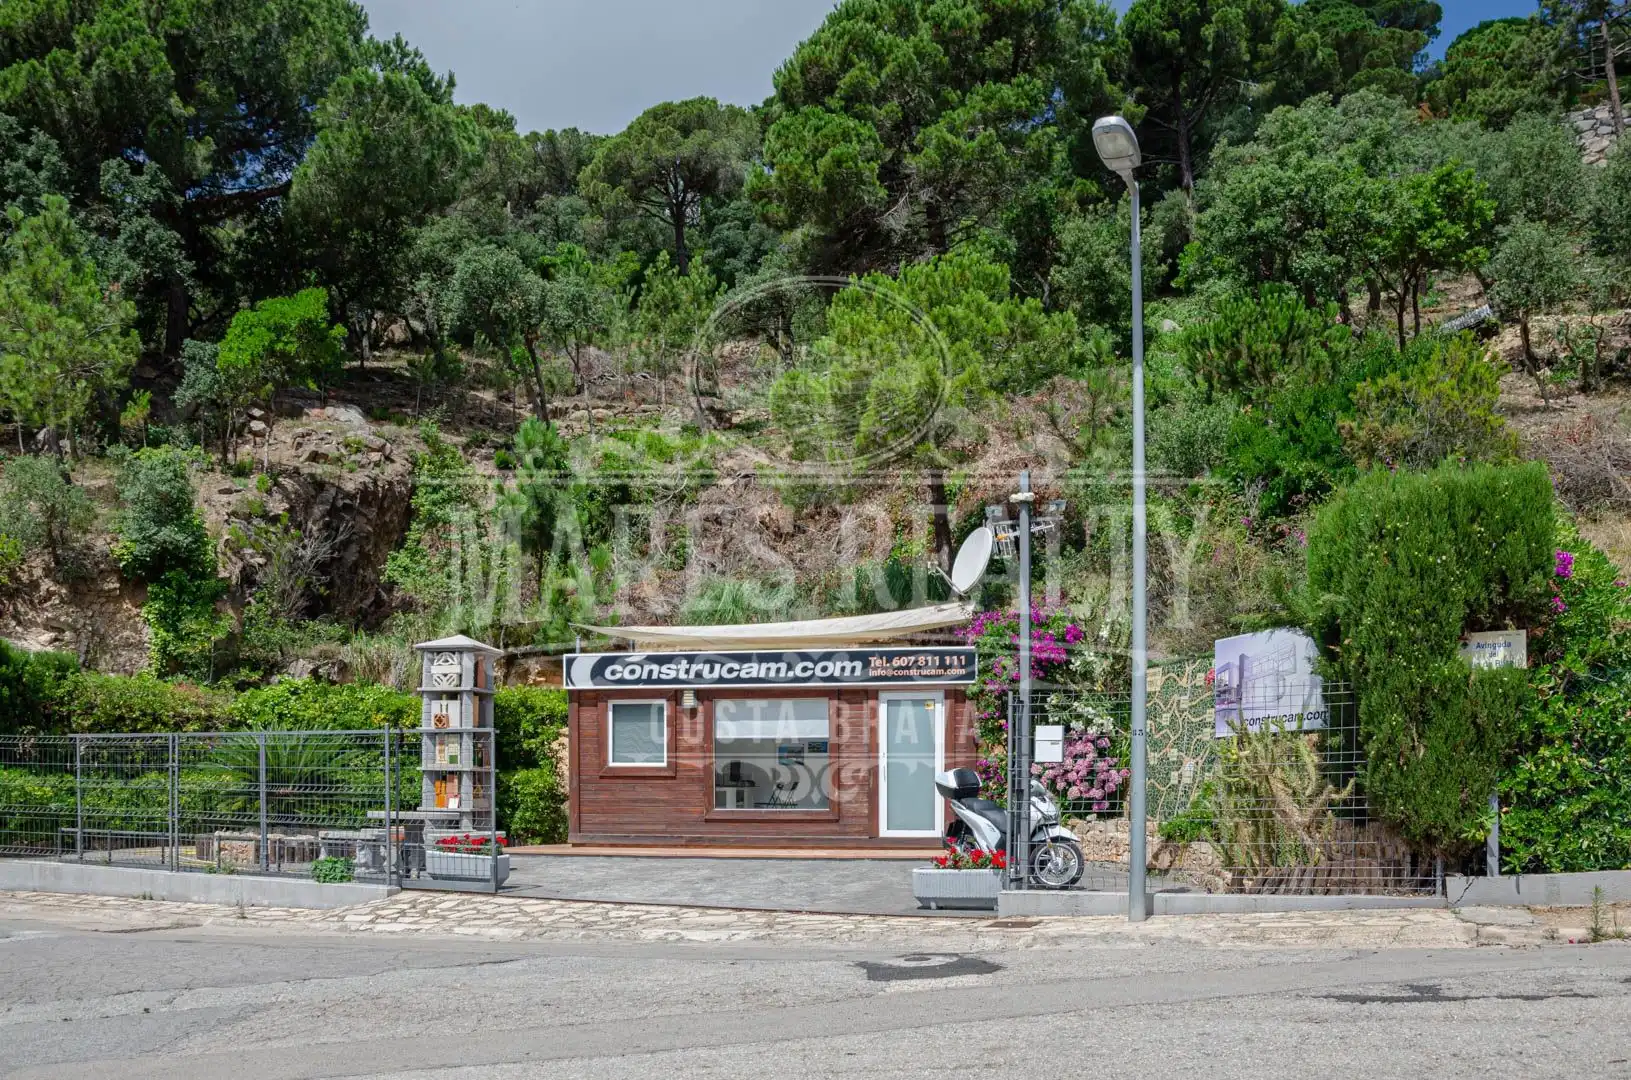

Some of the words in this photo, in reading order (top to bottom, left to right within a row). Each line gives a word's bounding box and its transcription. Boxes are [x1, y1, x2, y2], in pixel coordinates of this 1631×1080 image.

[1475, 640, 1512, 651] Avinguda
[868, 656, 890, 667] Tel.
[892, 655, 916, 667] 607
[917, 655, 940, 666] 811
[944, 655, 966, 666] 111
[604, 659, 863, 681] construcam.com
[868, 667, 966, 677] info@construcam.com
